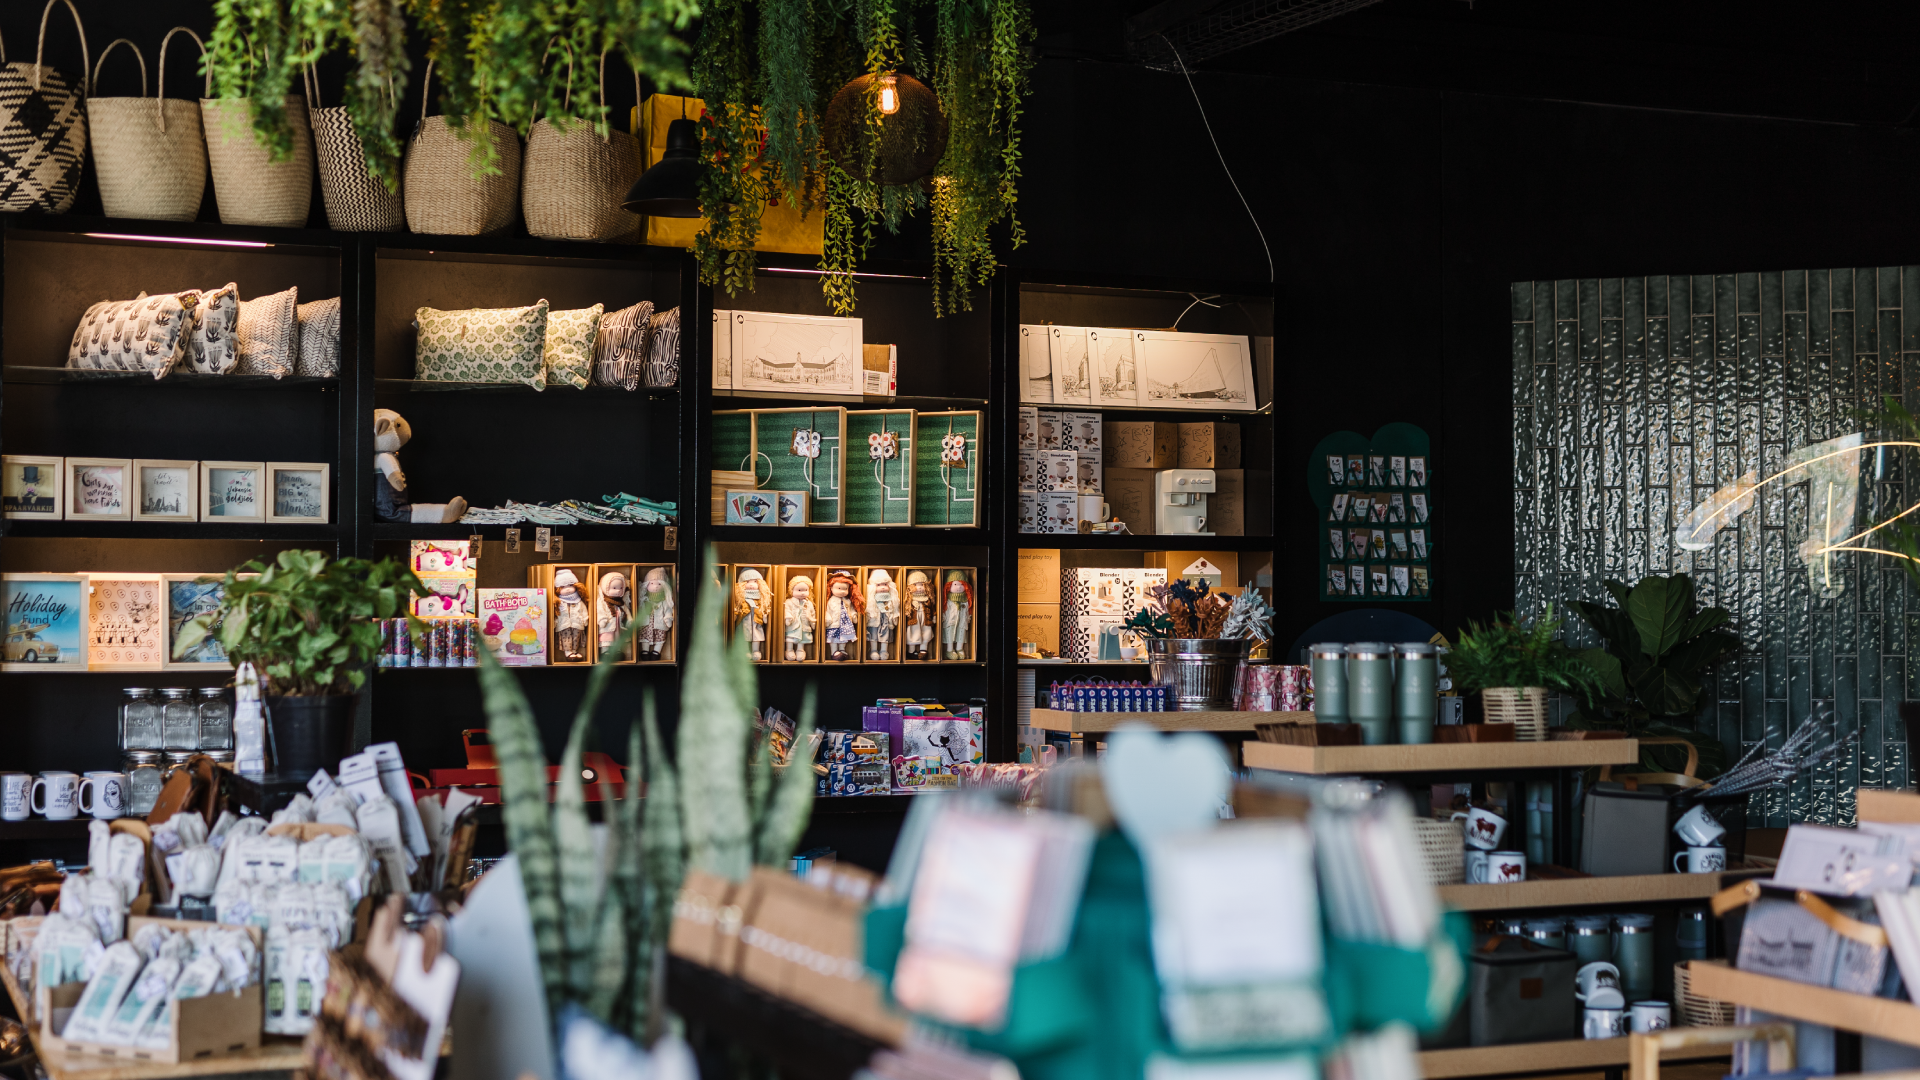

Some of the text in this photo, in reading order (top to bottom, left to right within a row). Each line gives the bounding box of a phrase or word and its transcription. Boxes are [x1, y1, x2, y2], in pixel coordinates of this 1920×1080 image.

[278, 488, 294, 496] BIG
[9, 591, 67, 621] Holiday
[485, 598, 528, 609] BATH BOMB
[22, 613, 50, 624] Fund
